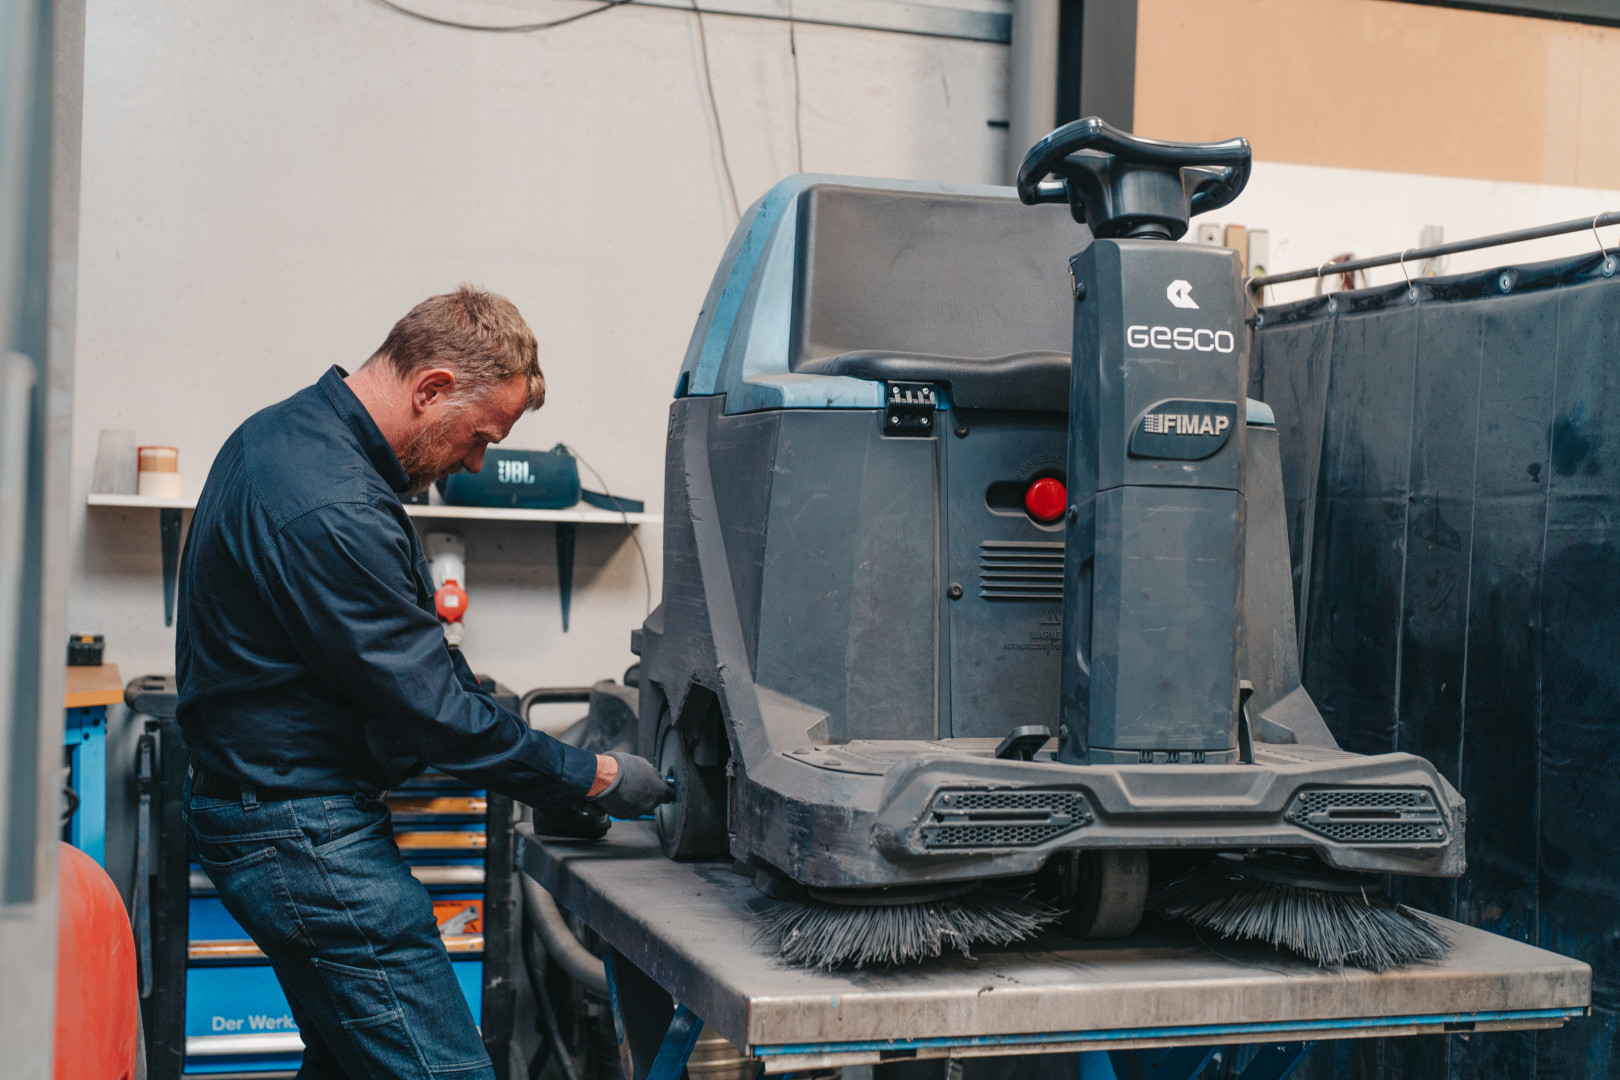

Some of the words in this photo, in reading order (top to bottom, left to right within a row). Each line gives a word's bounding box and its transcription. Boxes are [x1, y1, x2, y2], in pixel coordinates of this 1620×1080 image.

[1163, 414, 1229, 436] FIMAP
[498, 459, 536, 485] JBL
[212, 1015, 244, 1031] Der
[248, 1013, 298, 1031] Werk
